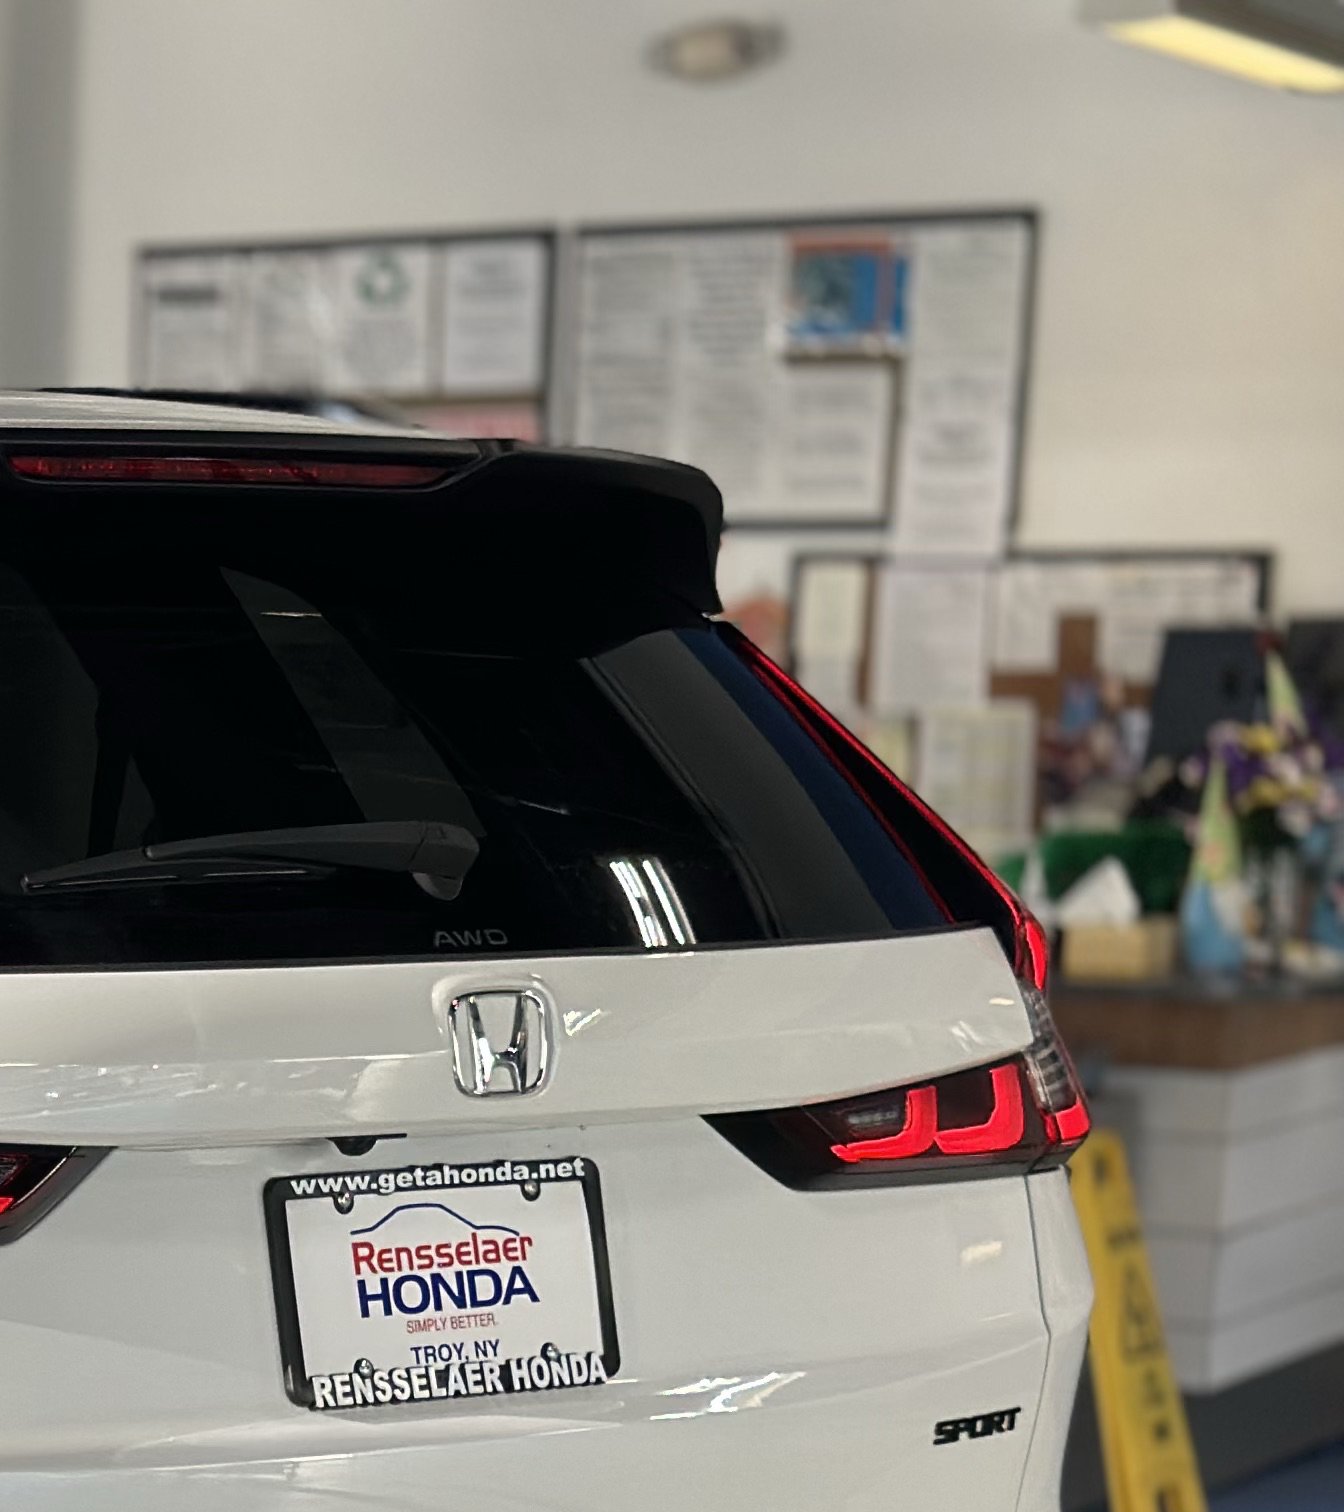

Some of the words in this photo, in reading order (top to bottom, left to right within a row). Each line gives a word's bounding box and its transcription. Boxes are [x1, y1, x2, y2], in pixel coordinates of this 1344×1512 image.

[433, 928, 509, 948] AWD
[290, 1156, 585, 1195] www.getahonda.net
[351, 1231, 533, 1276] Rensselaer
[357, 1265, 541, 1318] HONDA
[406, 1316, 447, 1334] SIMPLY
[410, 1341, 470, 1365] TROY,
[473, 1338, 500, 1360] NY
[312, 1361, 504, 1409] RENSSELAER
[510, 1352, 609, 1391] HONDA
[933, 1406, 1022, 1445] SPORT
